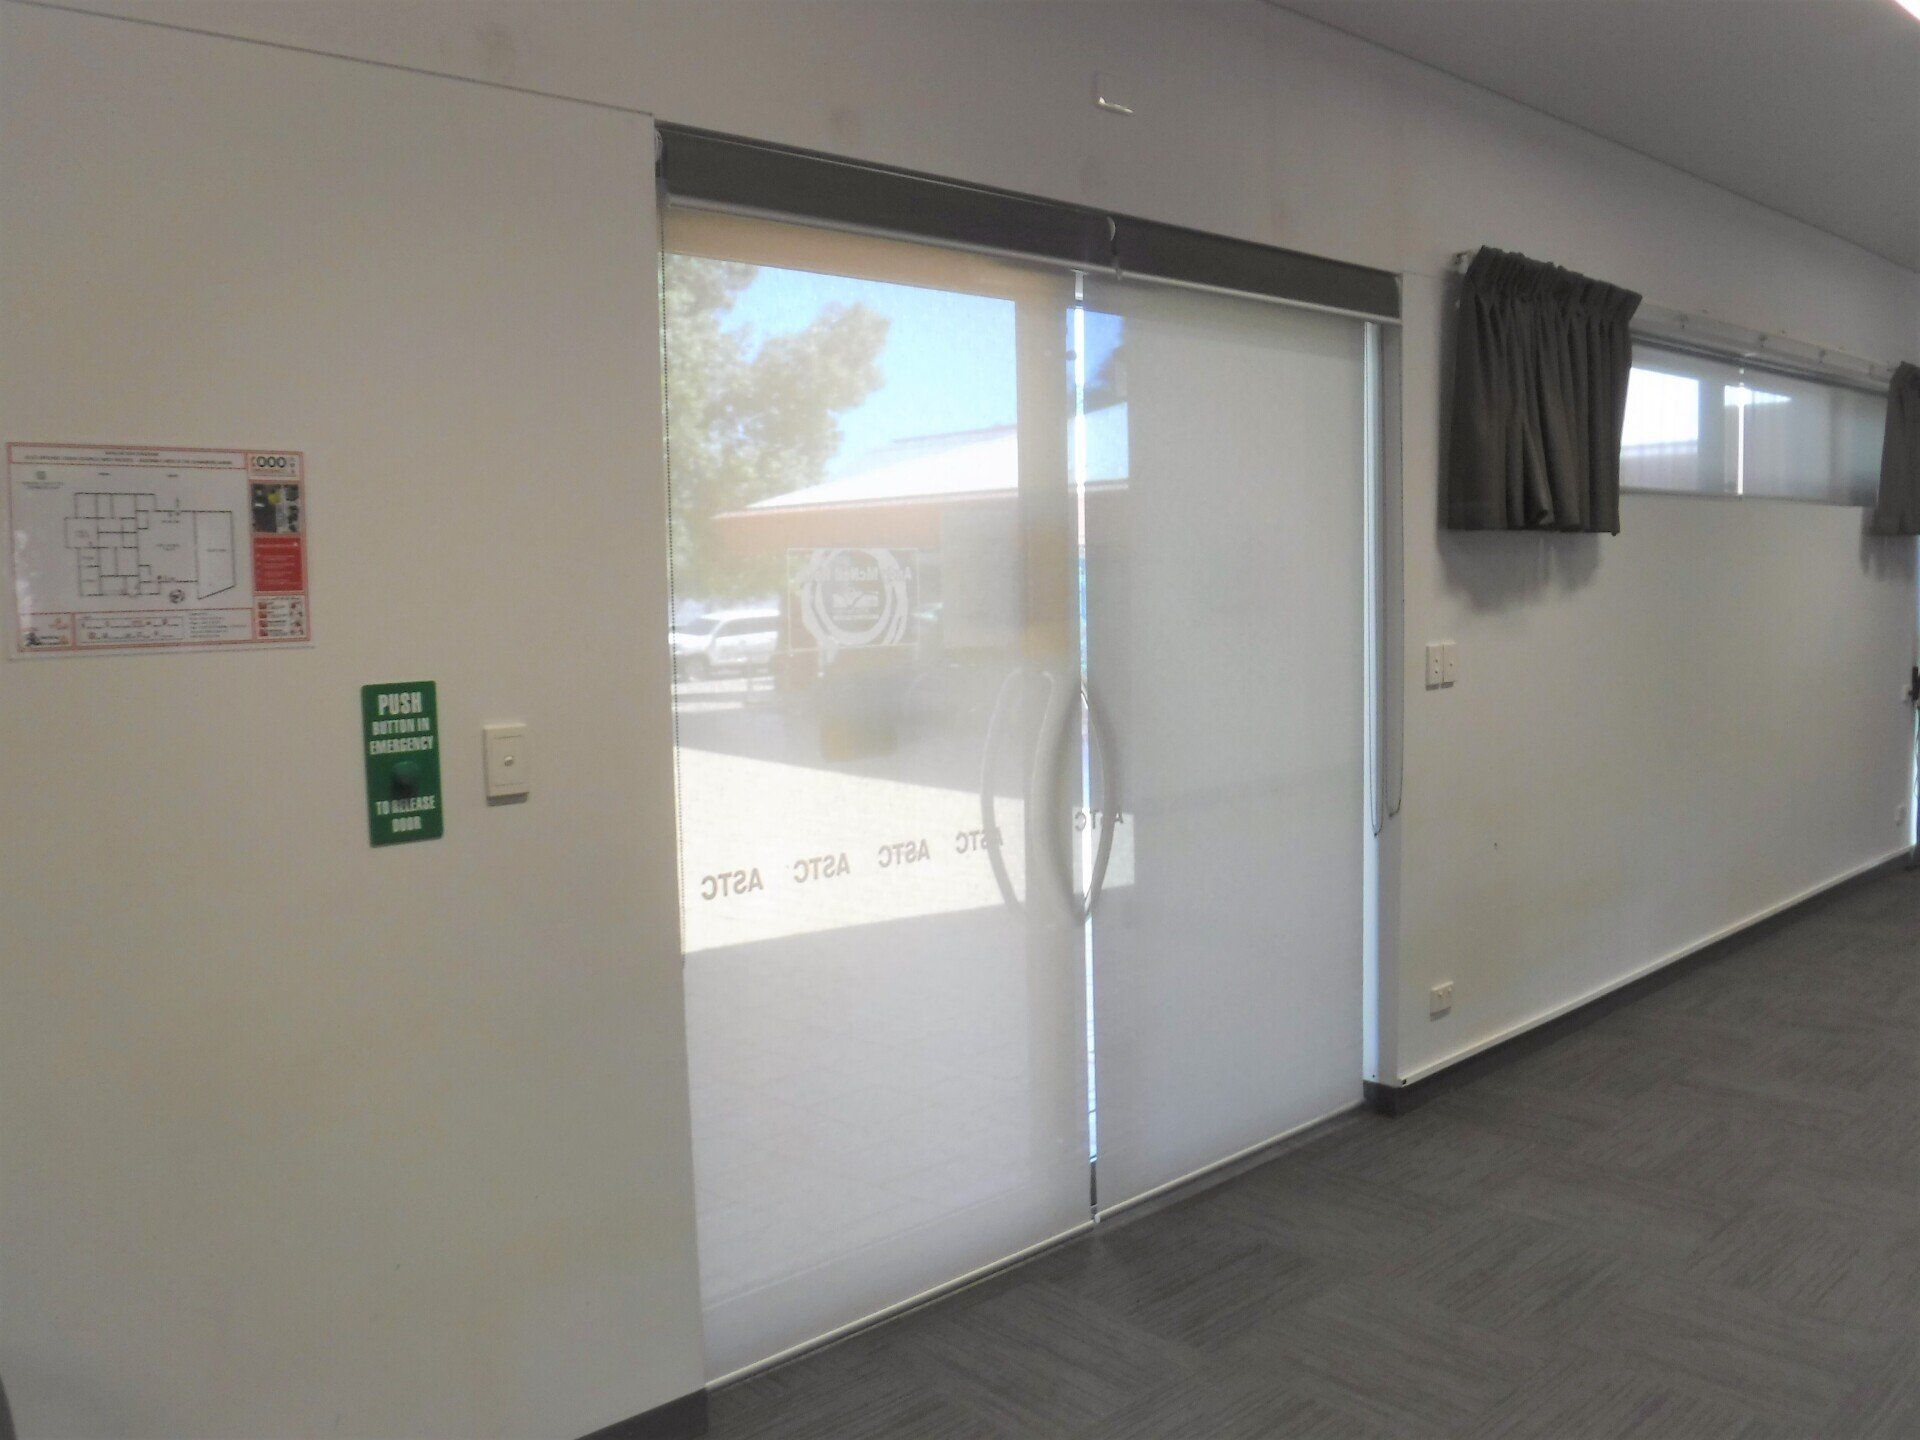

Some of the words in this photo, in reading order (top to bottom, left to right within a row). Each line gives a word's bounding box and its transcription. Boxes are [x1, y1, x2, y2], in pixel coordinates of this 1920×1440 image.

[377, 692, 423, 716] PUSH
[372, 718, 416, 736] BUTTON
[417, 717, 431, 732] IN
[369, 736, 435, 755] EMERGENCY
[376, 800, 391, 816] TO
[390, 795, 437, 815] RELEASE
